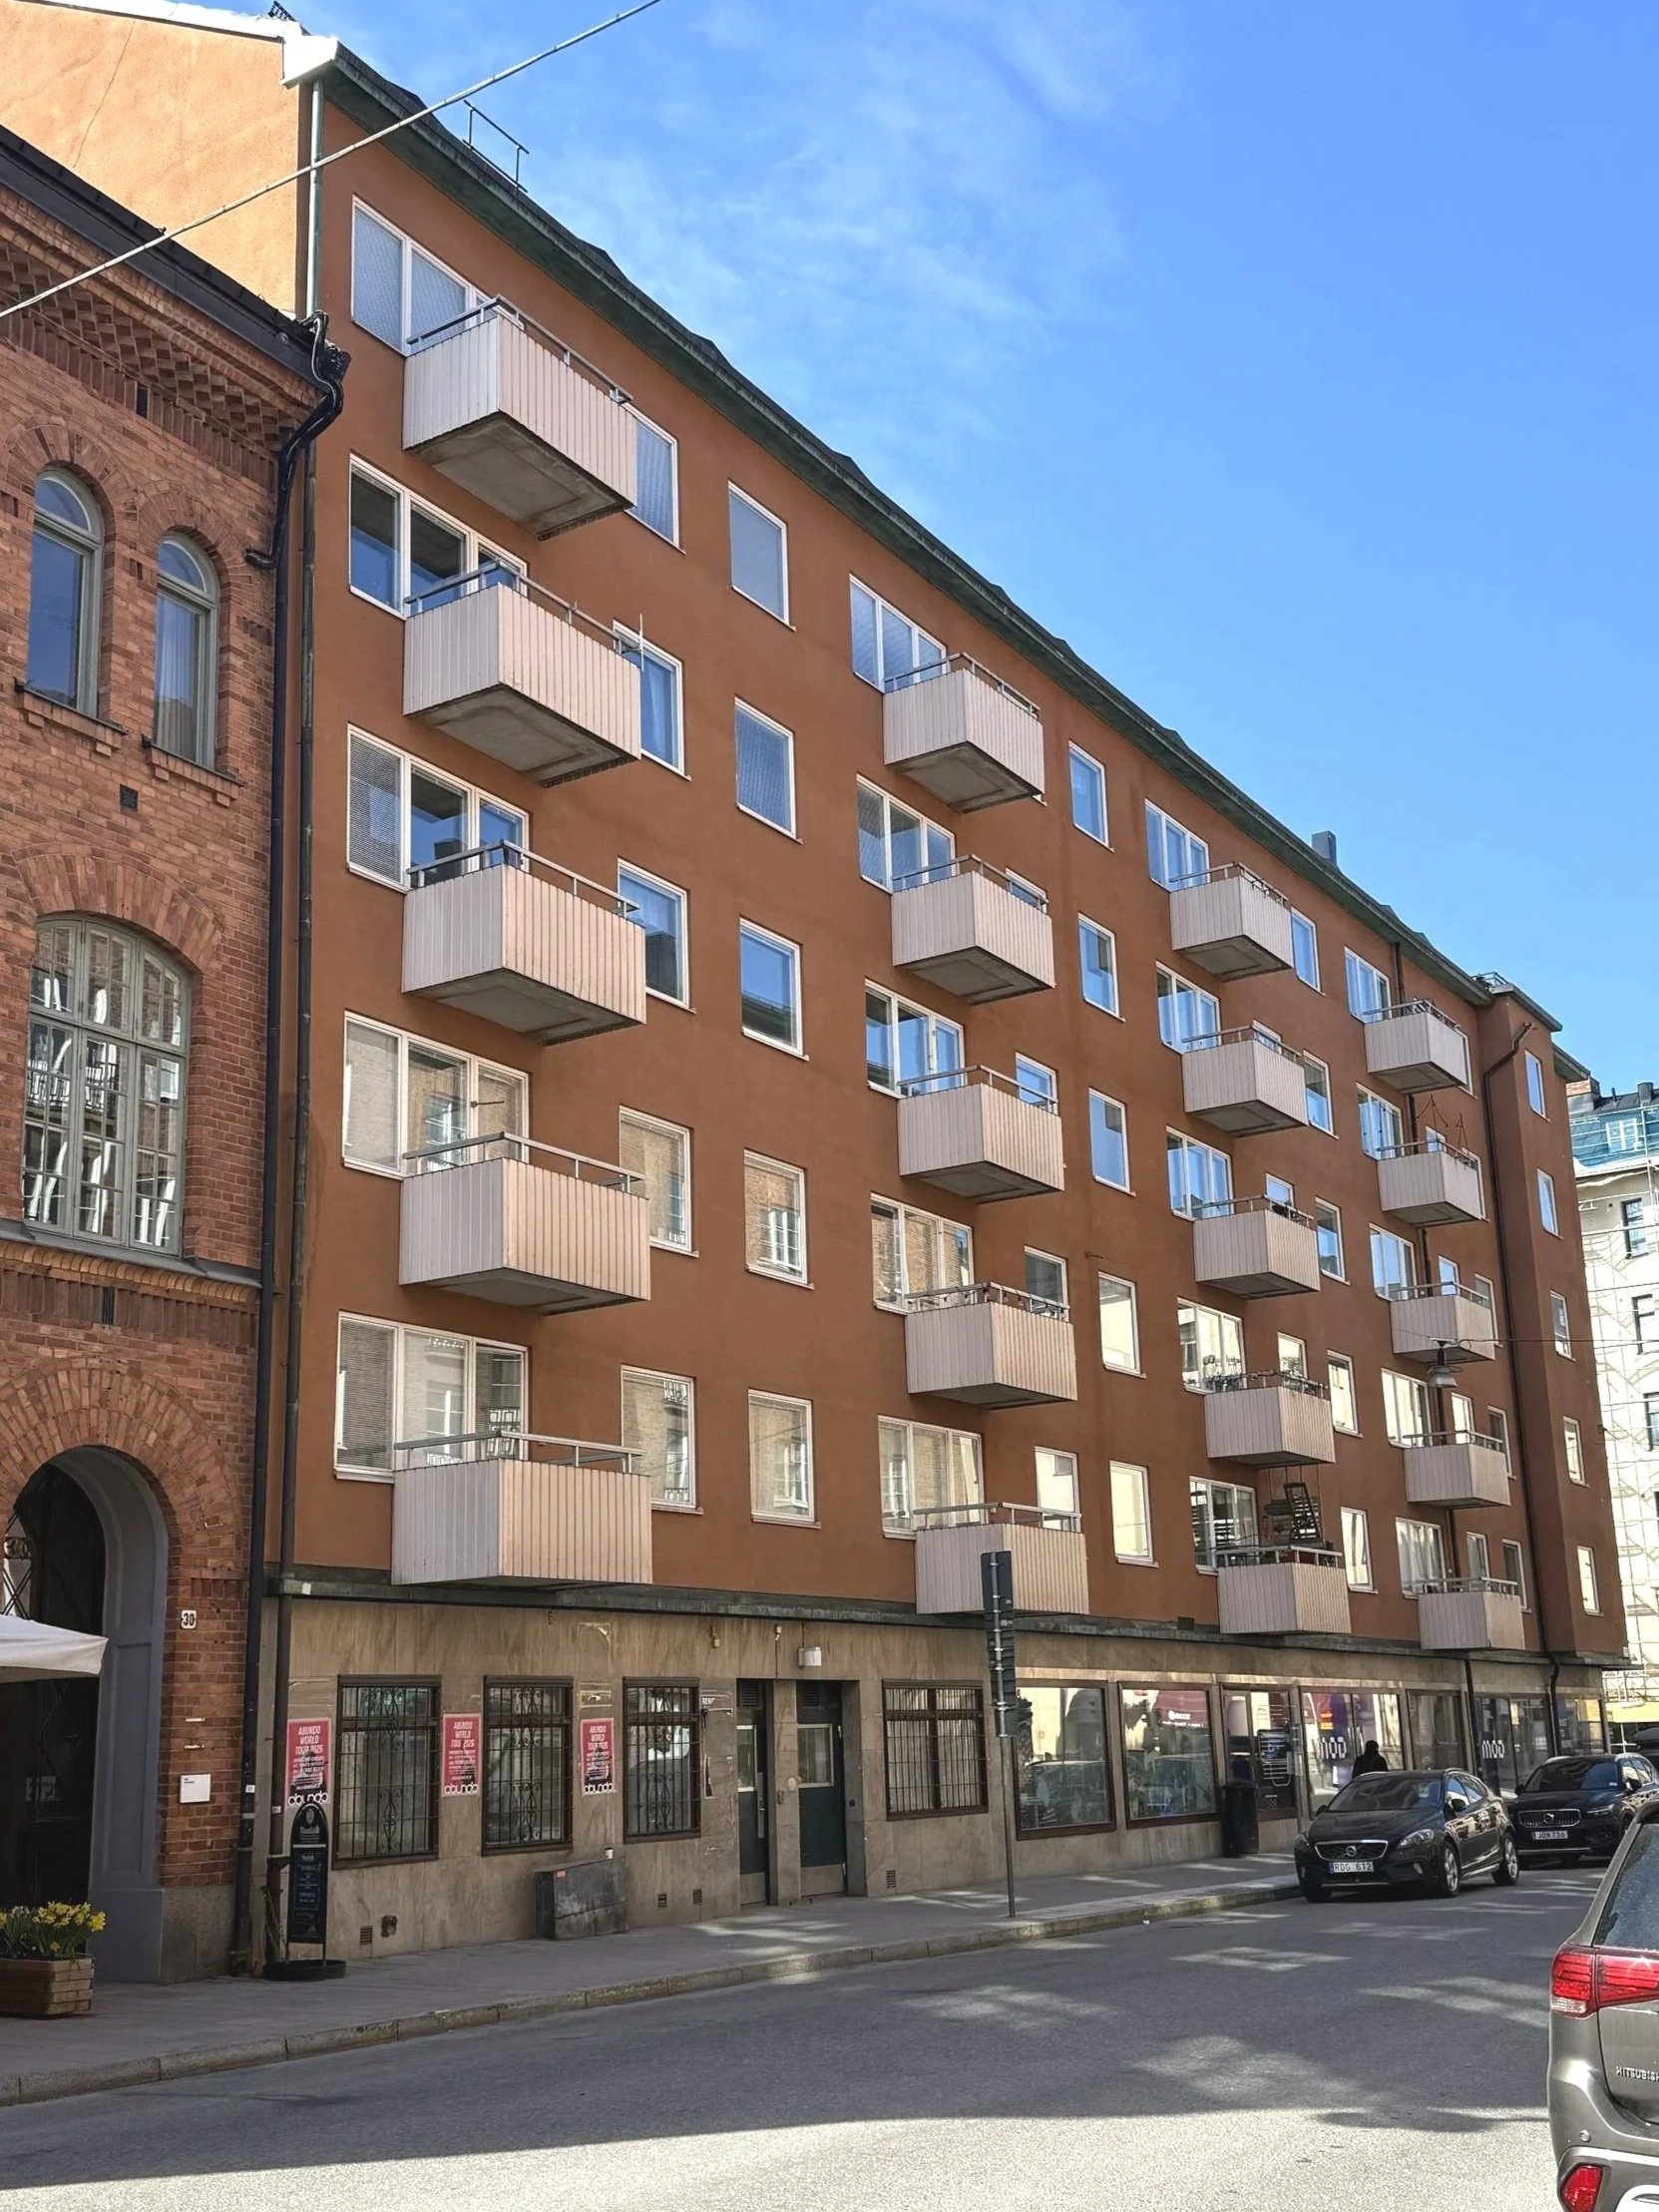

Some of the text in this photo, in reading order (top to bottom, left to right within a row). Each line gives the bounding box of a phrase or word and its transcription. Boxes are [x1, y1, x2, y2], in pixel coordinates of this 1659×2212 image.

[183, 1613, 196, 1626] 30
[298, 1725, 320, 1736] ABUNDO
[299, 1735, 319, 1745] WORLD
[444, 1781, 479, 1794] abundo
[584, 1781, 614, 1794] abundo
